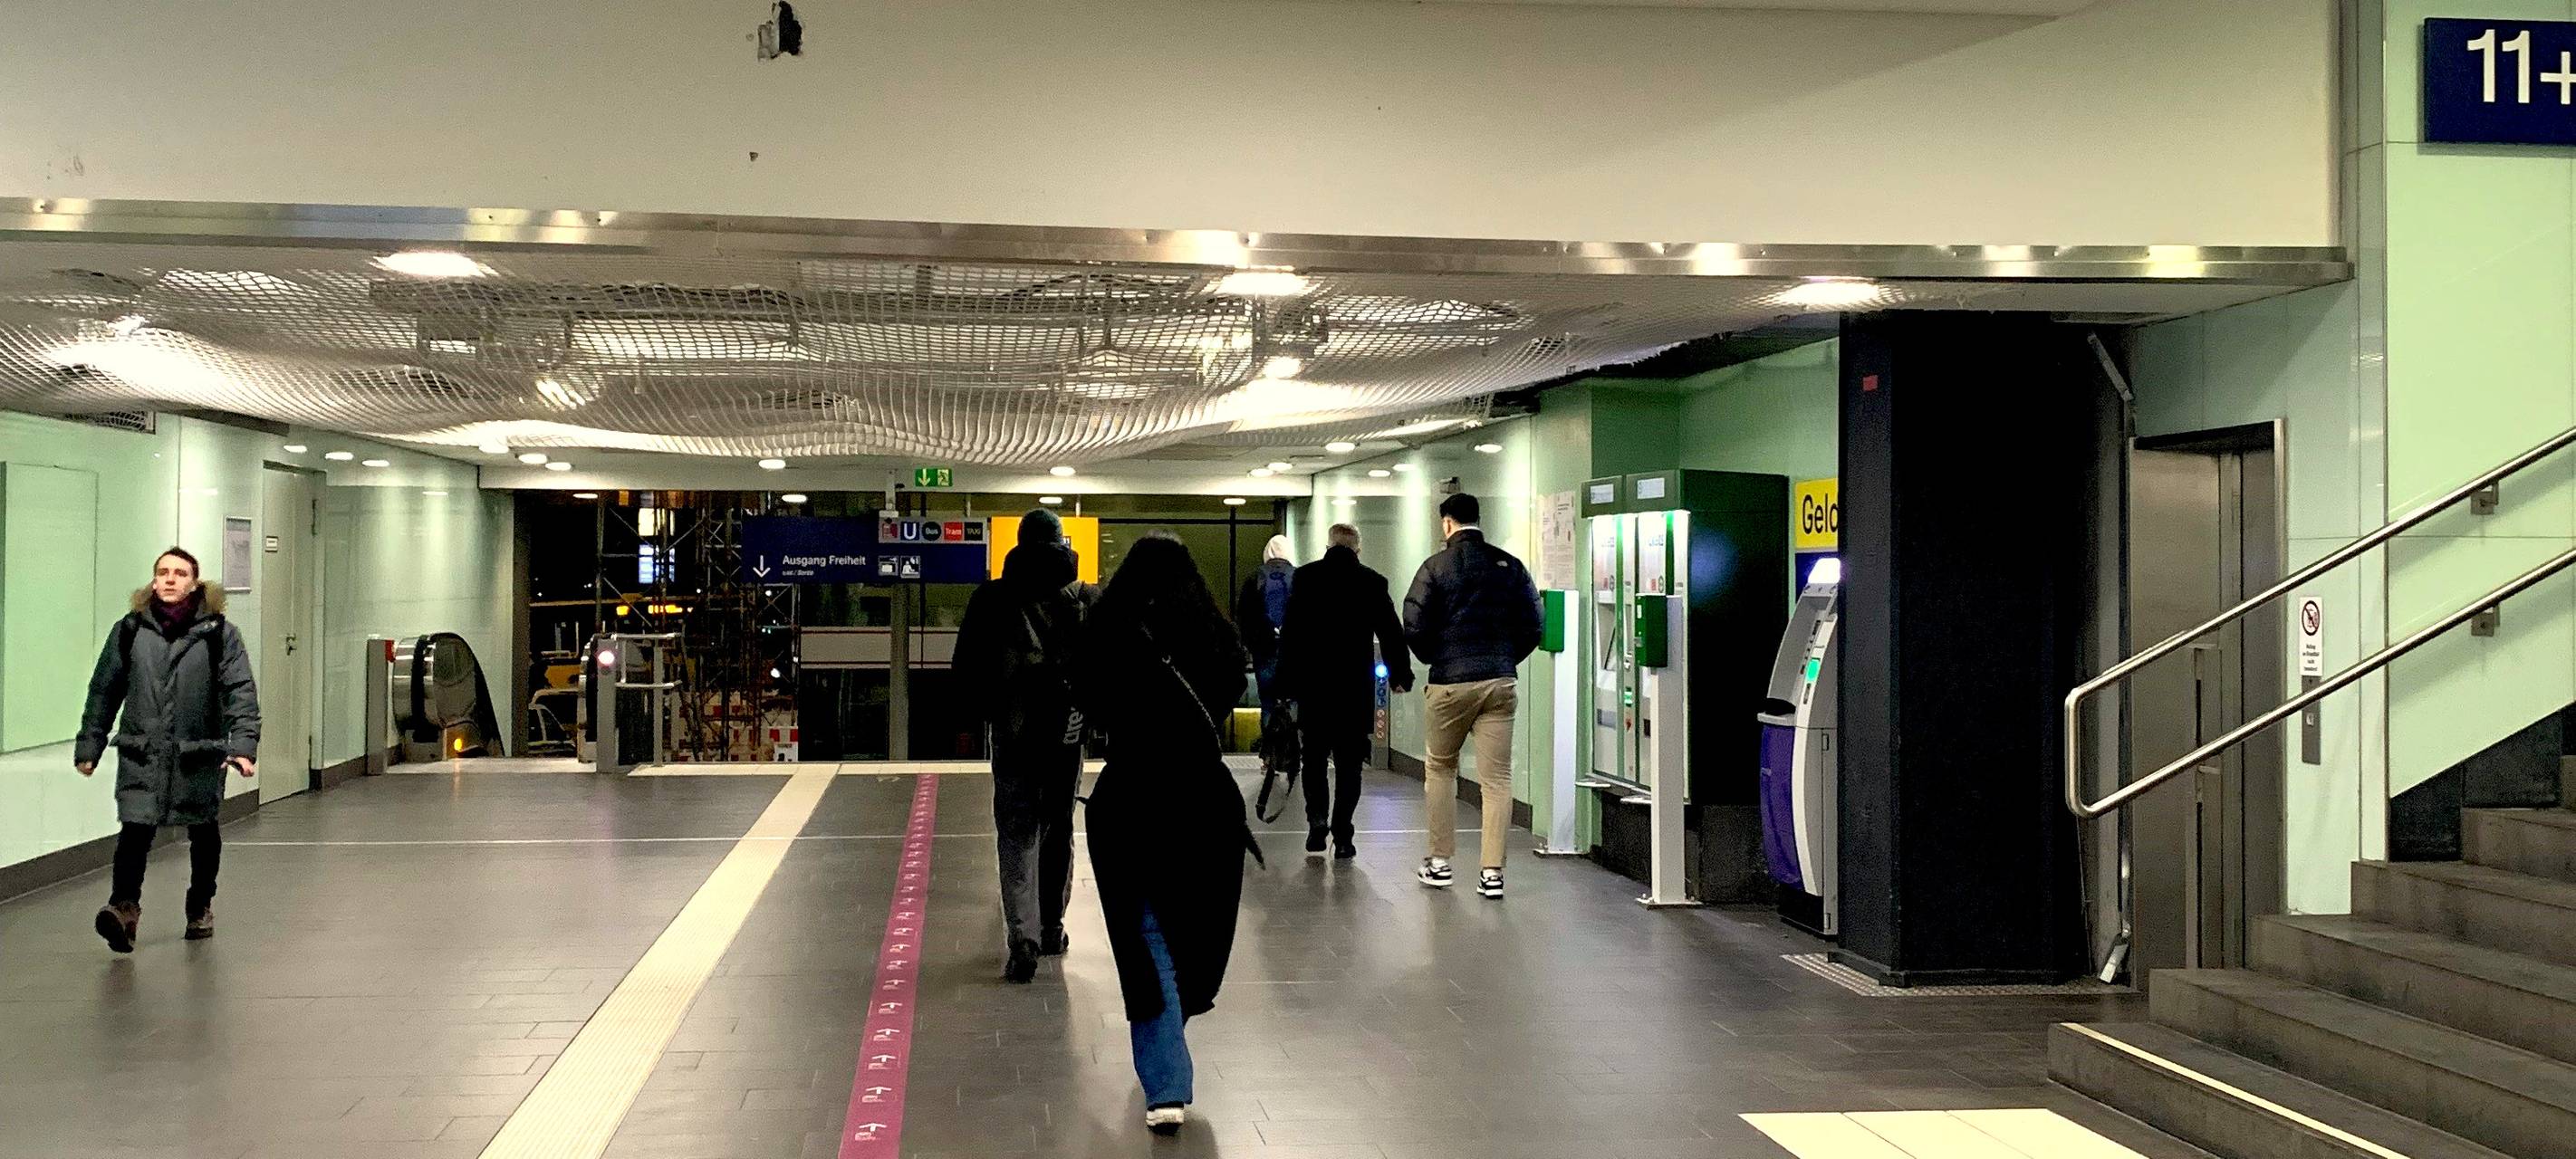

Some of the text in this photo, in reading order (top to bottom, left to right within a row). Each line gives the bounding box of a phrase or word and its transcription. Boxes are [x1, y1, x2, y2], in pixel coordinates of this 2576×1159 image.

[904, 522, 917, 540] U
[925, 527, 939, 535] Bus
[945, 527, 962, 536] Tram
[782, 555, 866, 568] Ausgang Freiheit
